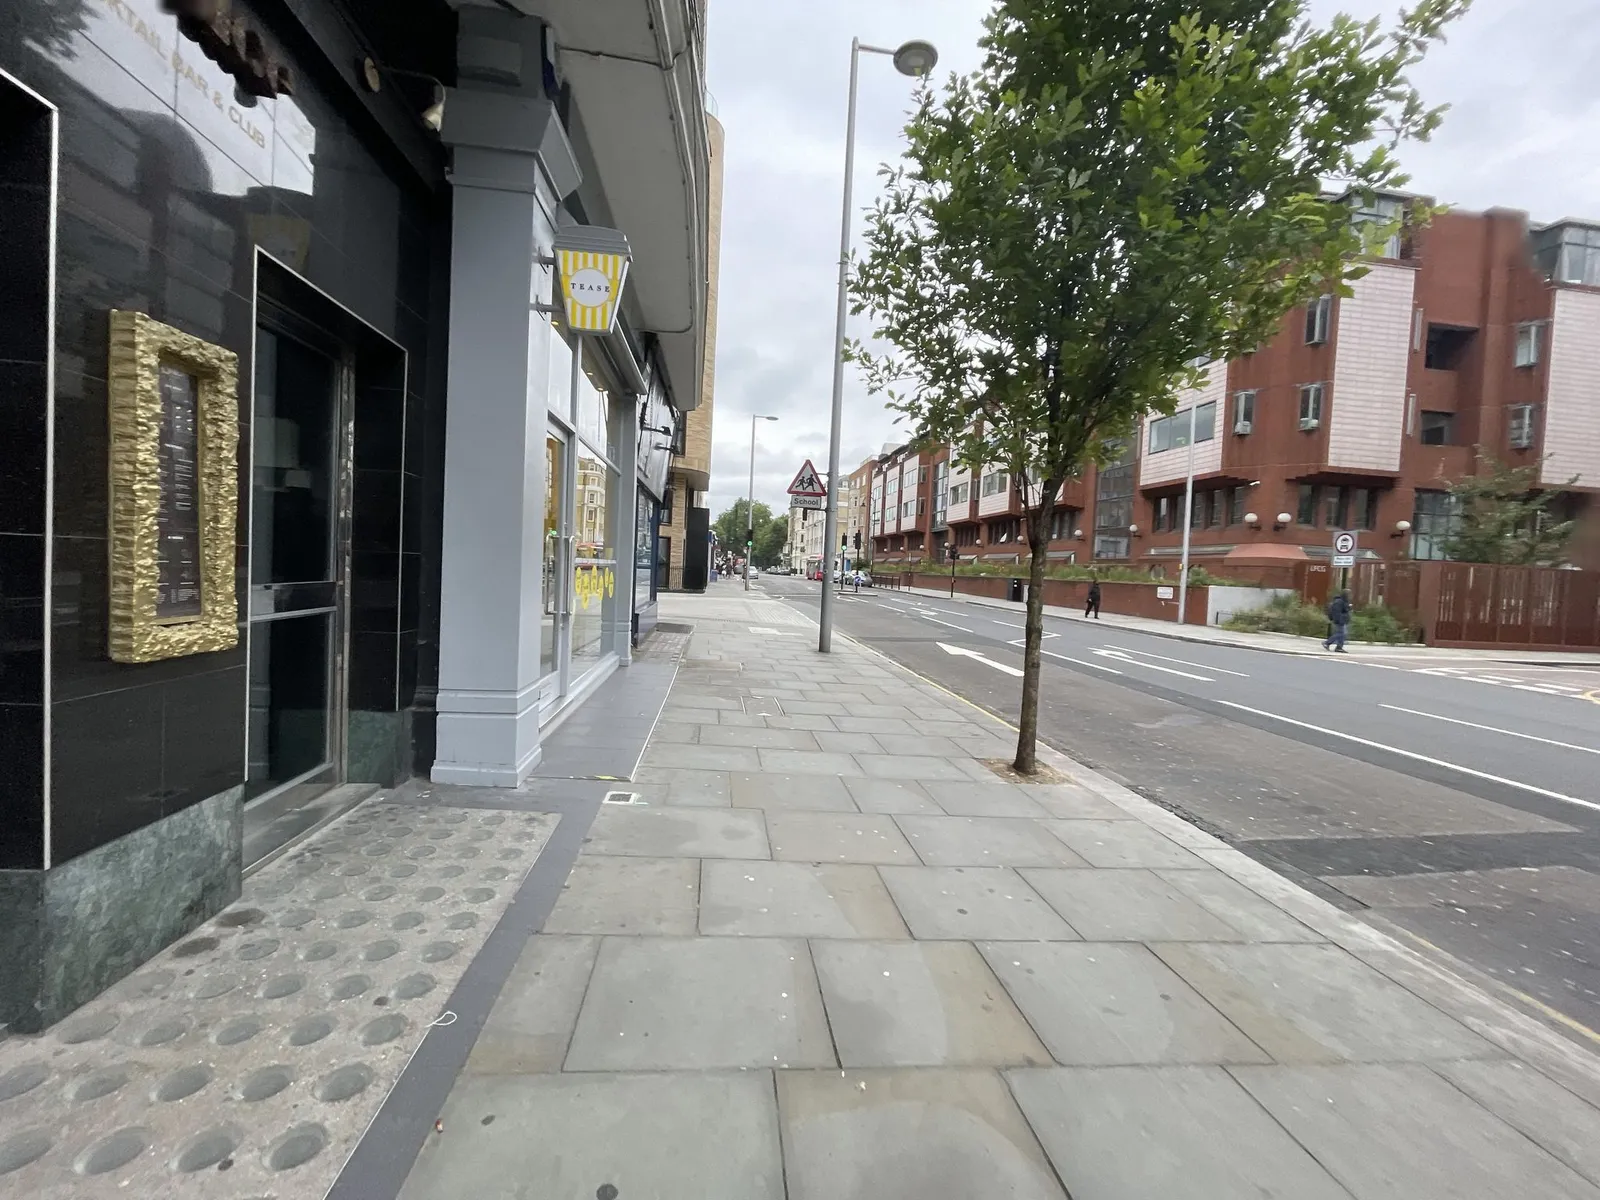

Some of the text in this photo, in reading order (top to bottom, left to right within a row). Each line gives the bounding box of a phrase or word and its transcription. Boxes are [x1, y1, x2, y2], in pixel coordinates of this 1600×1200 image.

[171, 51, 210, 99] BAR
[212, 91, 224, 113] &
[228, 106, 265, 149] CLUB
[571, 282, 610, 293] TEASE
[794, 498, 818, 506] School
